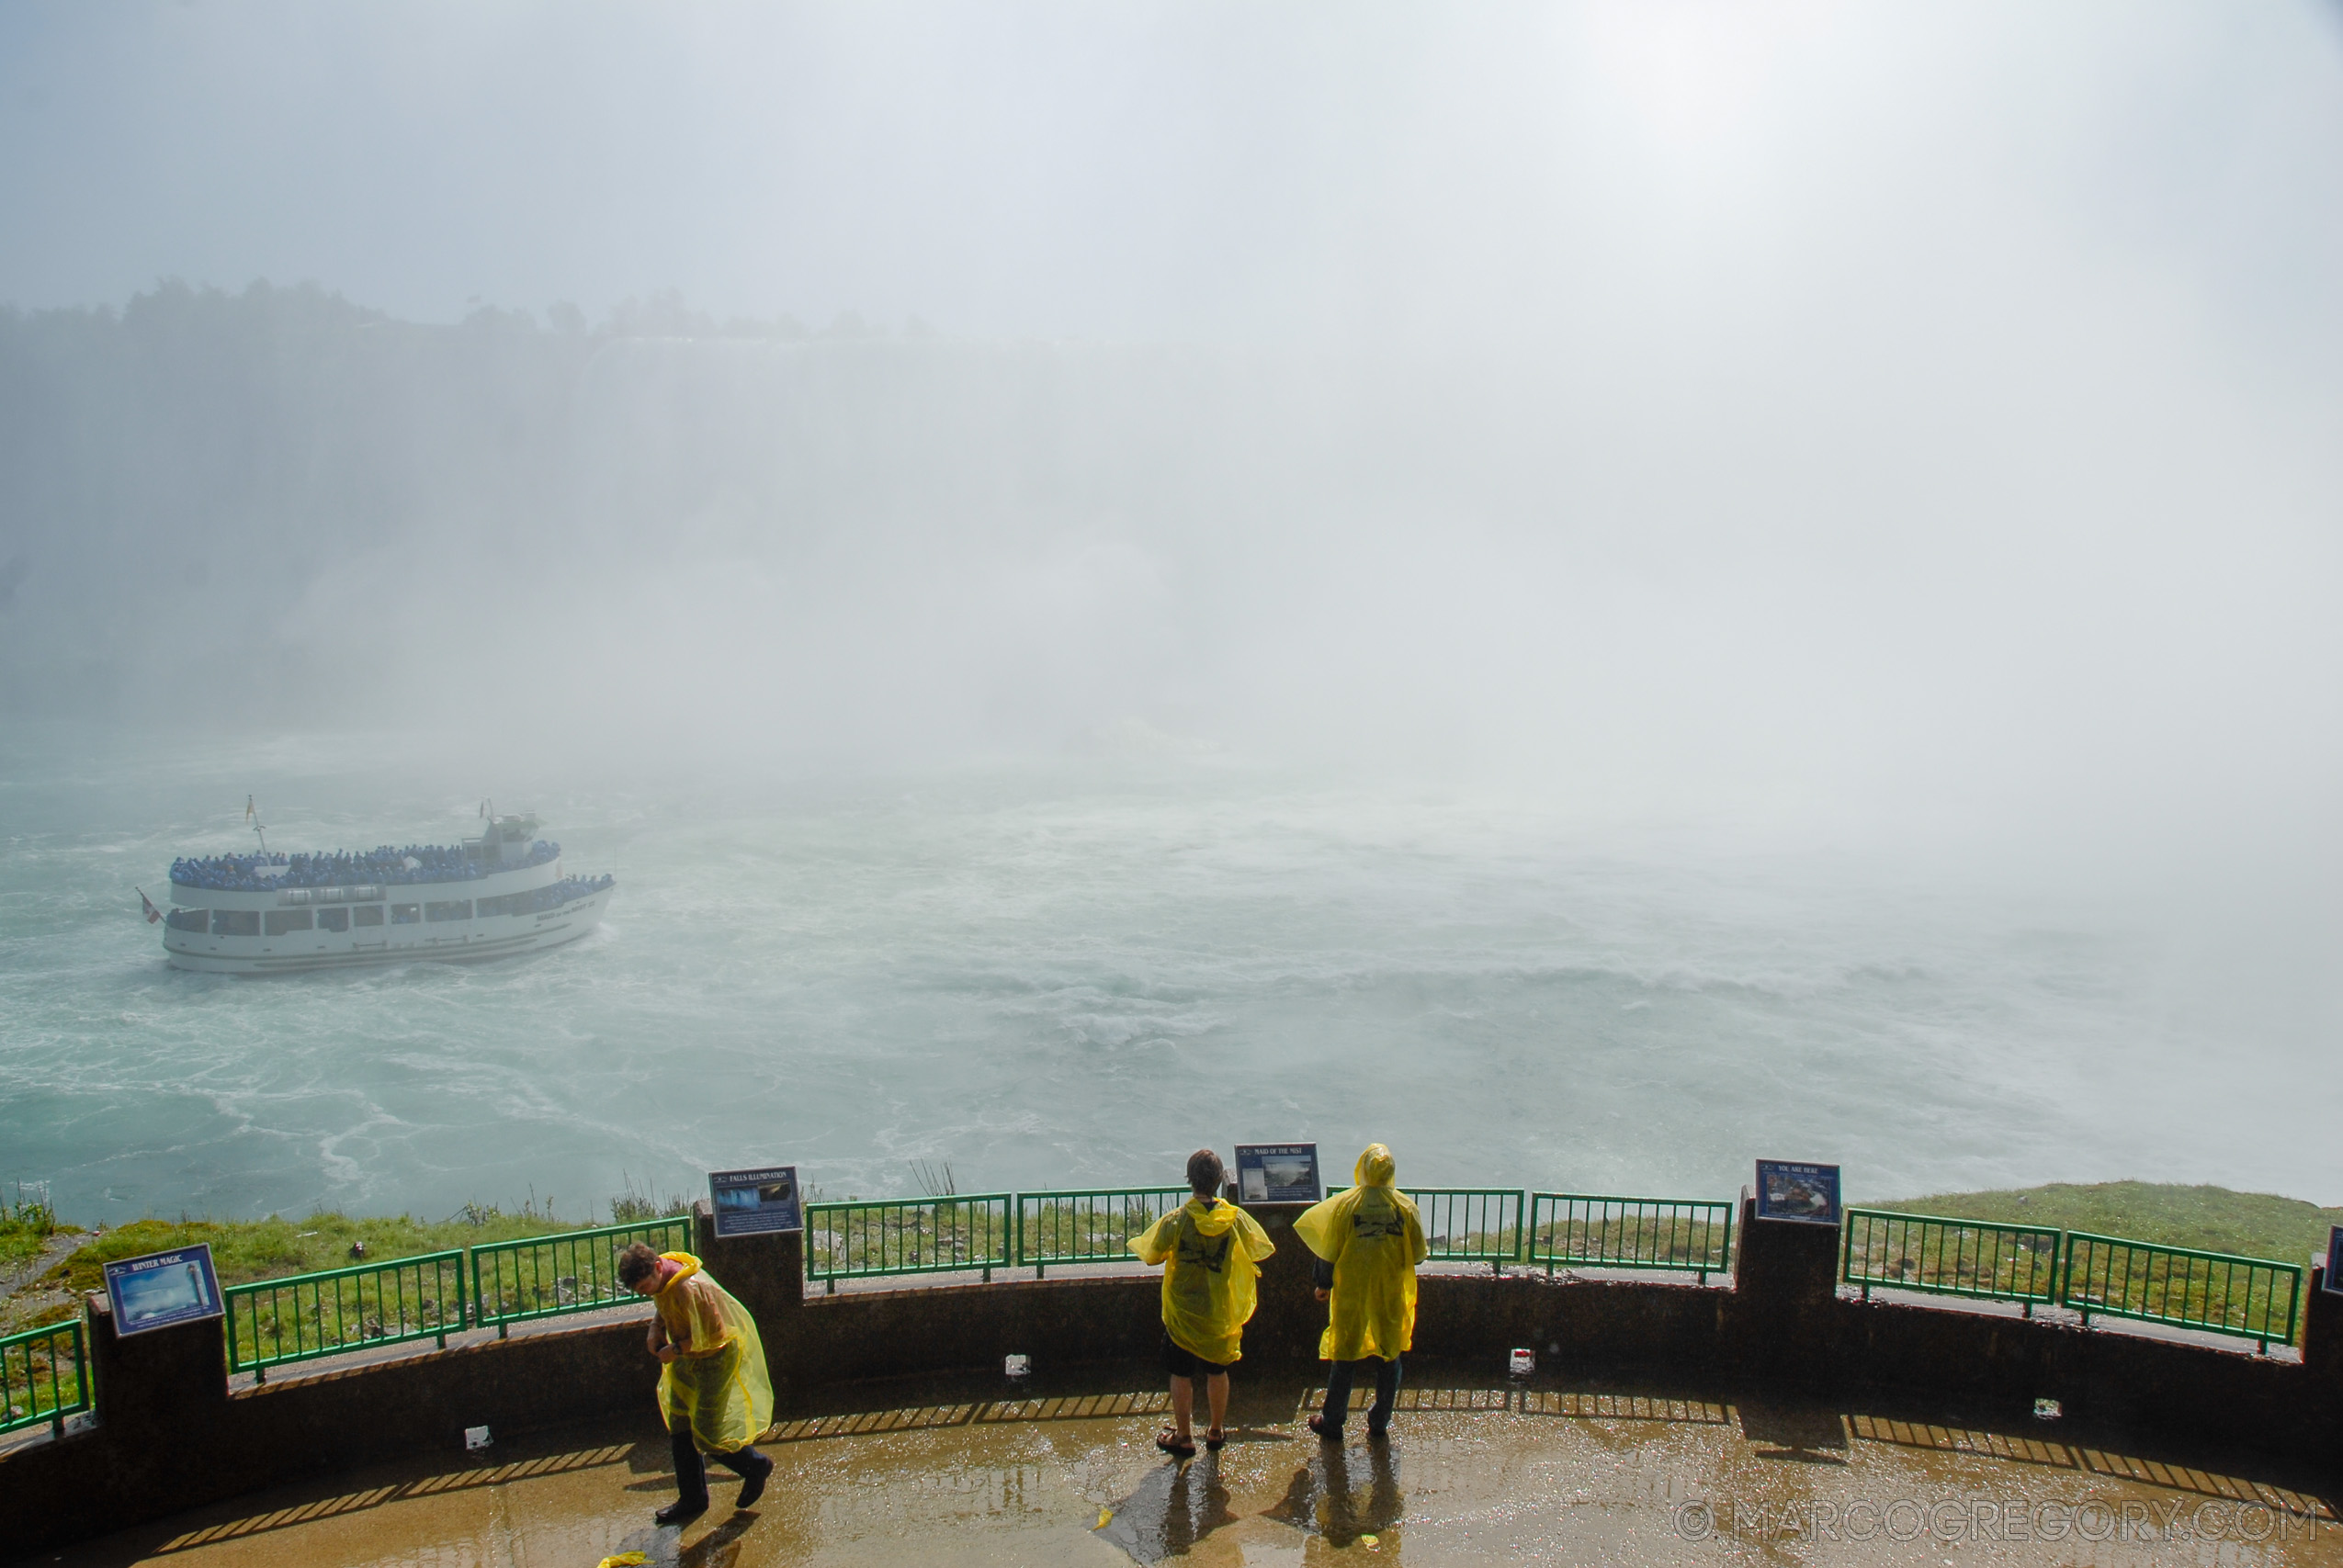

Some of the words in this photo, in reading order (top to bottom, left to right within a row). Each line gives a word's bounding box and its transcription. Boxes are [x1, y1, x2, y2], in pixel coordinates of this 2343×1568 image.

[730, 1174, 747, 1182] FALLS
[748, 1171, 787, 1180] ILLUMINATION
[132, 1259, 159, 1270] WINTER
[160, 1255, 183, 1265] MAGIC
